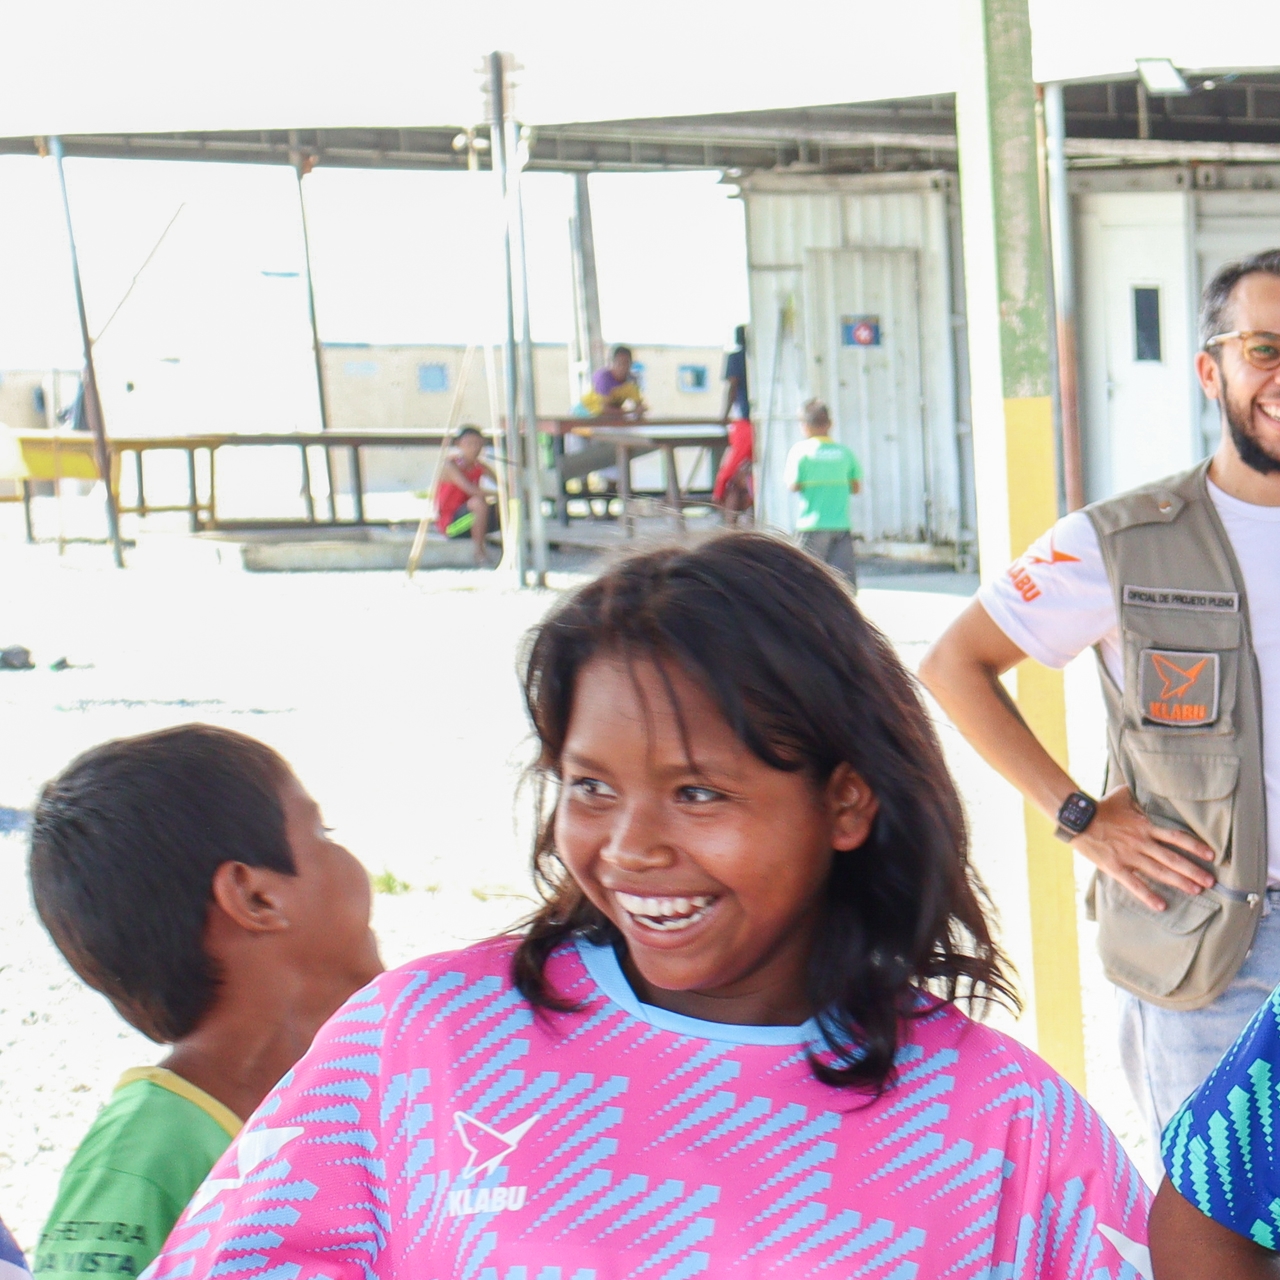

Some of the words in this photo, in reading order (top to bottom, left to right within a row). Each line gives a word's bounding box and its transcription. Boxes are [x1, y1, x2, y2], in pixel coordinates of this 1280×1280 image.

[1006, 561, 1042, 603] LABU
[1159, 593, 1169, 604] DE
[1171, 593, 1207, 606] PROJETO
[1149, 701, 1207, 722] KLABU
[447, 1186, 528, 1217] KLABU
[42, 1219, 148, 1246] FEITURA
